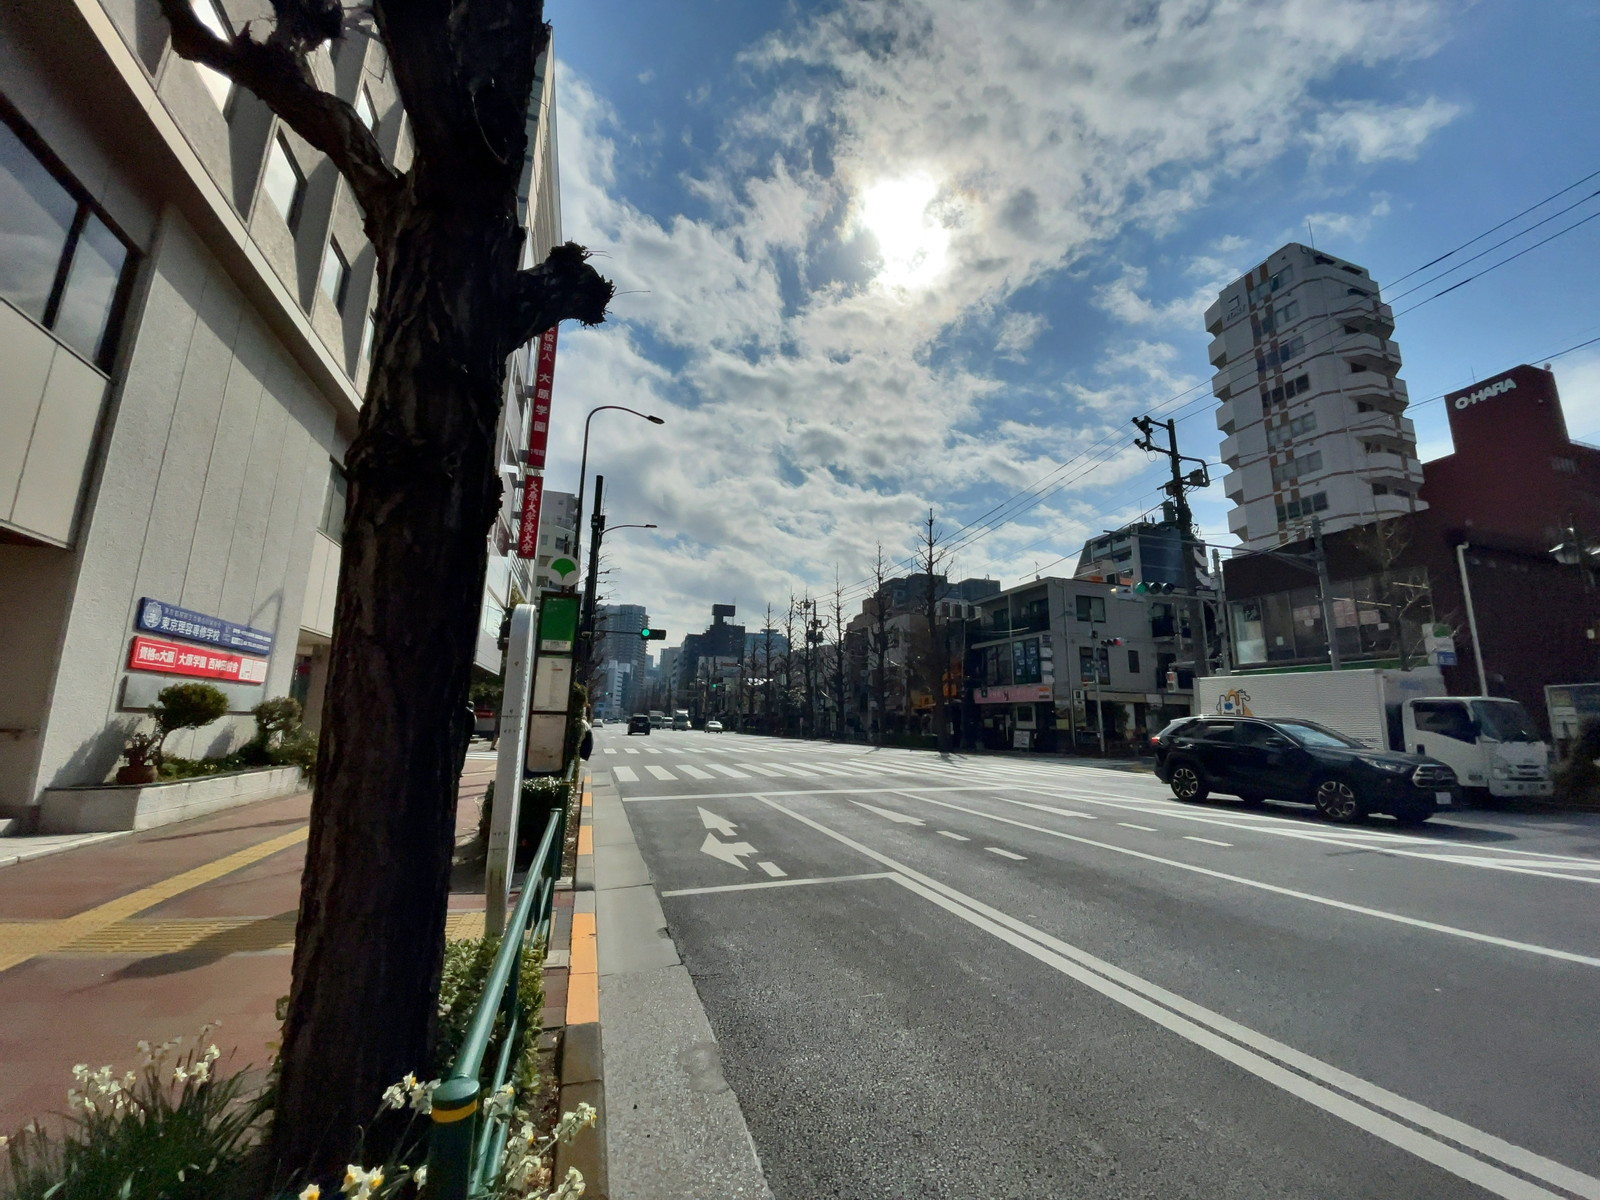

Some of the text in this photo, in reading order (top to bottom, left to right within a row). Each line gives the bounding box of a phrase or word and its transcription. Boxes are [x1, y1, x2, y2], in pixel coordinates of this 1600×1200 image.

[533, 373, 551, 433] 大原学園
[521, 480, 539, 554] 大原大学院大学
[161, 616, 220, 642] 東京理容専修学校
[139, 646, 176, 663] 資格の大原
[178, 652, 207, 669] 大原学園
